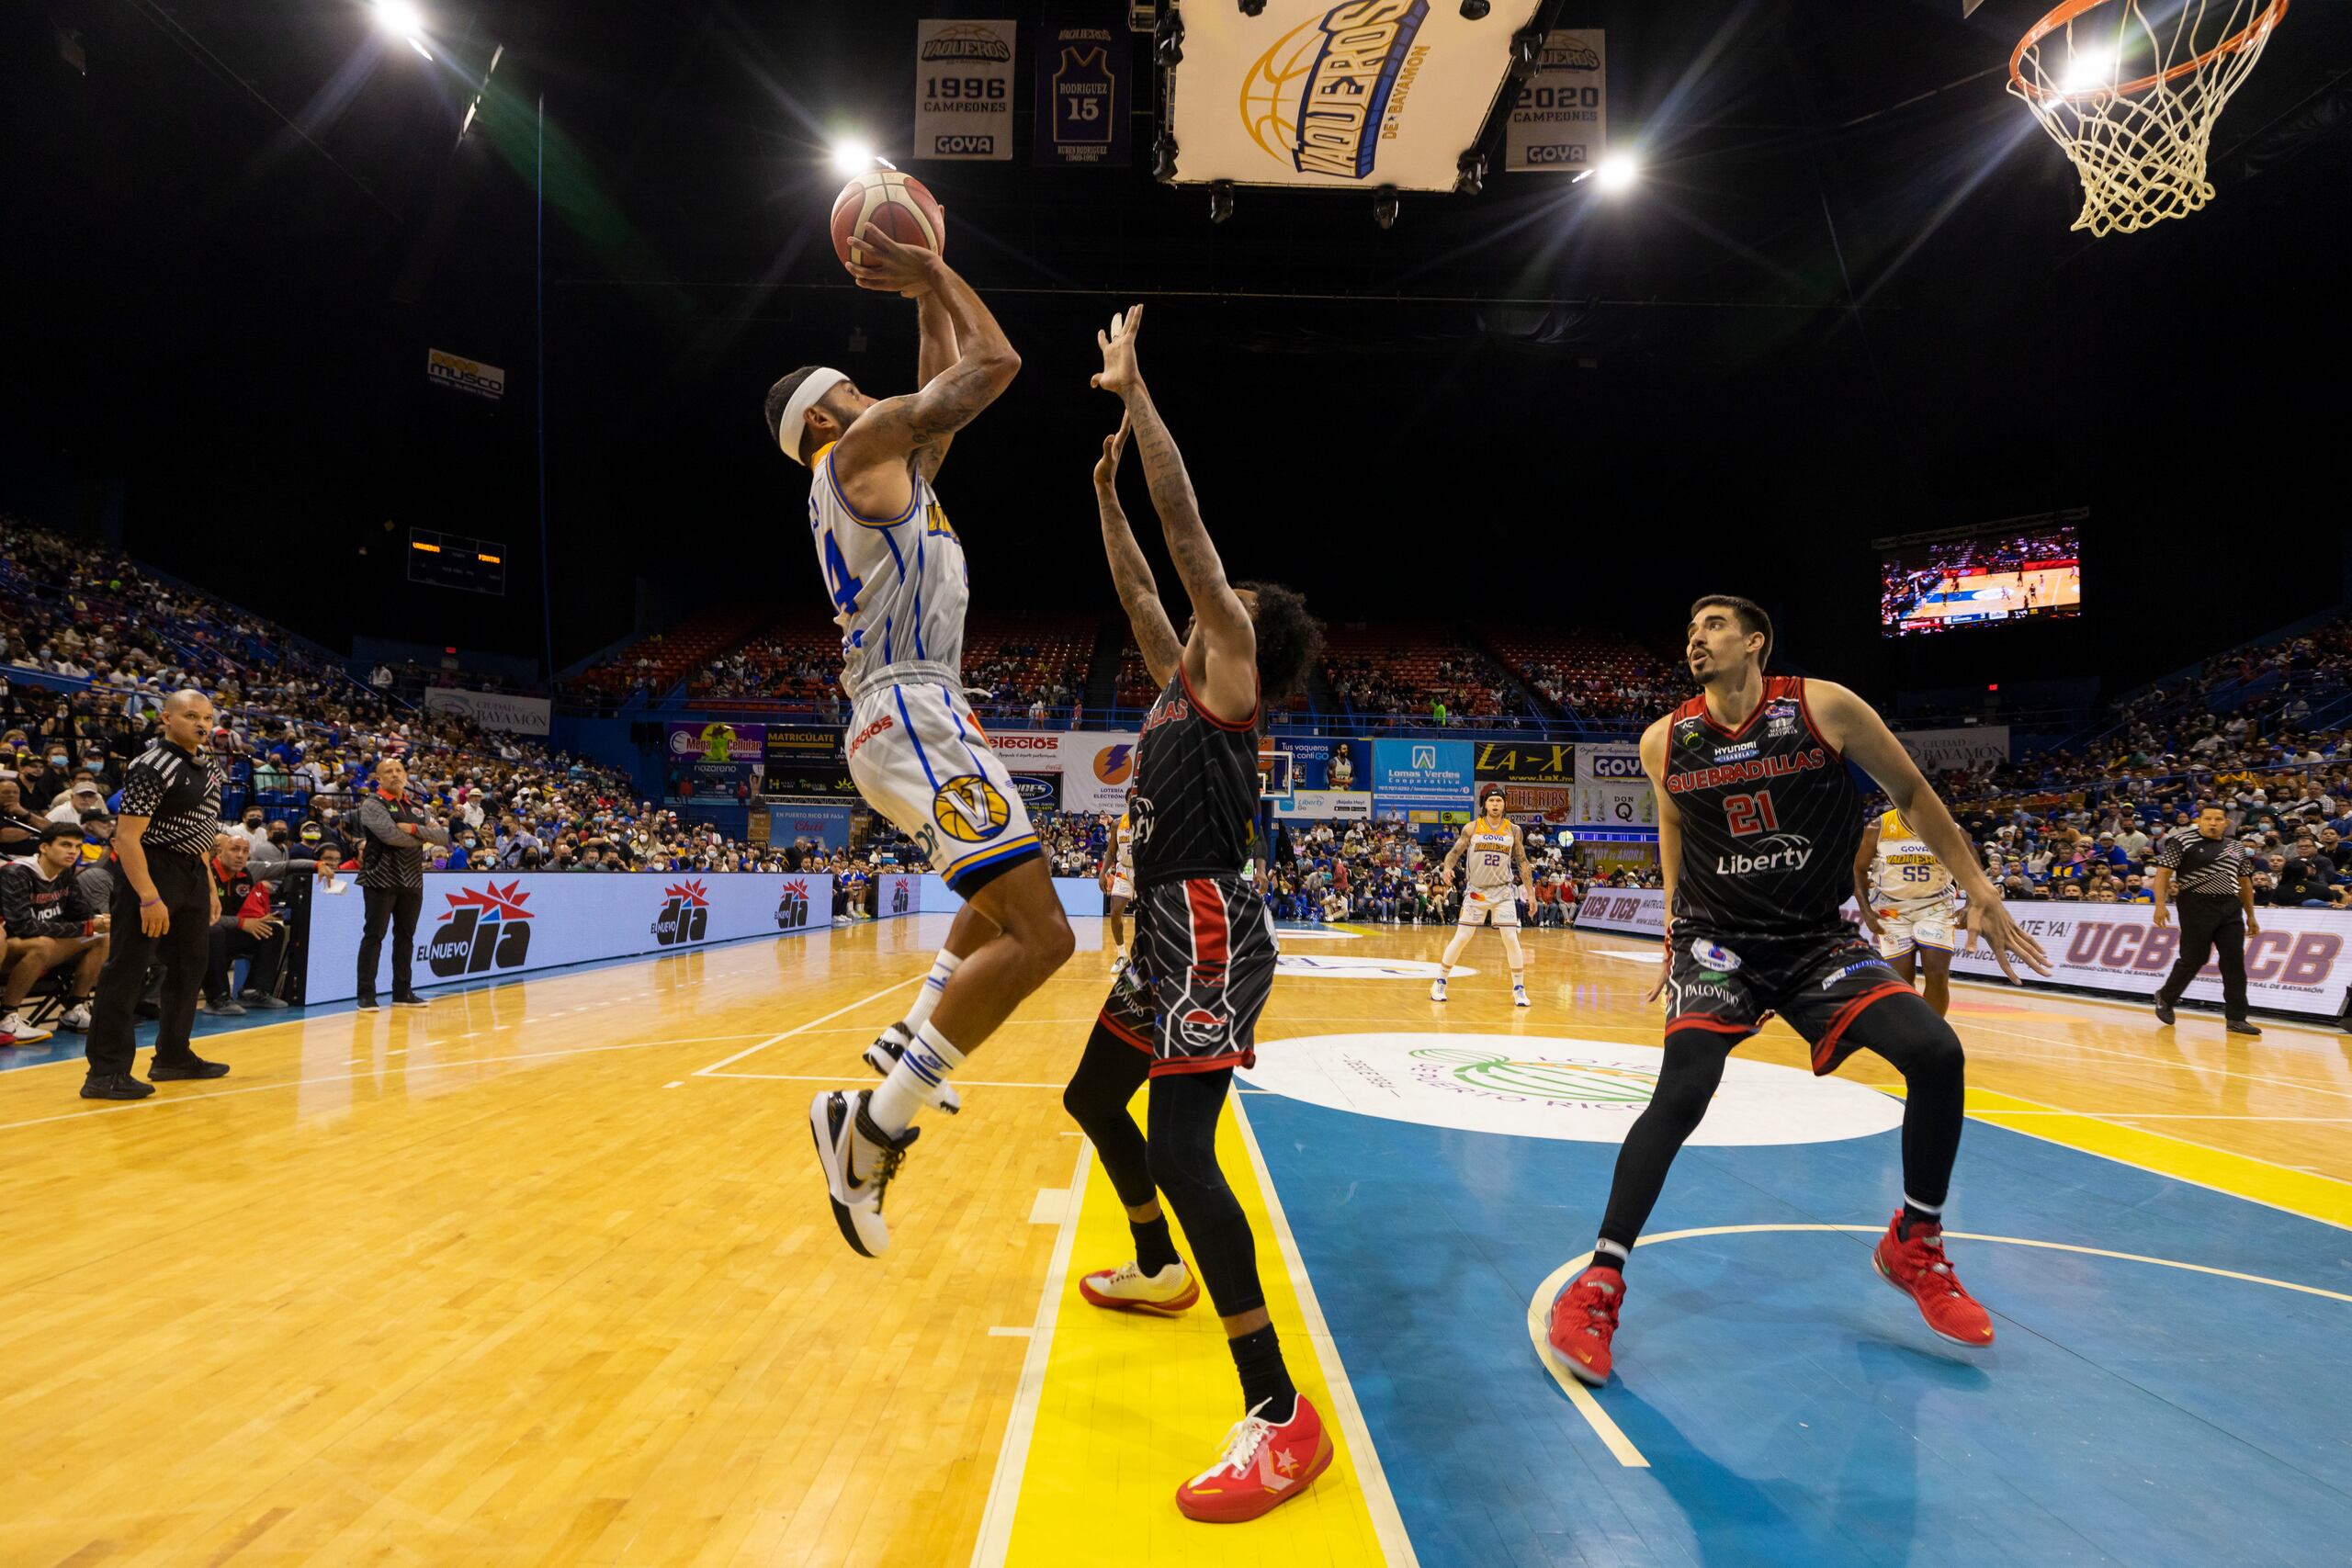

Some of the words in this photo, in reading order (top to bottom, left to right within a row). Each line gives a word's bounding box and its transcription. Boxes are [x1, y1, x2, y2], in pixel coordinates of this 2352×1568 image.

[1058, 28, 1112, 41] VAQUEROS
[922, 39, 1010, 62] VAQUEROS
[1541, 49, 1600, 71] UEROS
[927, 77, 1005, 98] 1996
[1387, 46, 1431, 114] BAYAMON
[1059, 84, 1108, 95] RODRIGUEZ
[1291, 0, 1430, 180] VAQUEROS
[1515, 87, 1599, 108] 2020
[924, 102, 1007, 113] CAMPEONES
[1068, 97, 1100, 120] 15
[1514, 110, 1598, 123] CAMPEONES
[1381, 123, 1399, 140] DE
[936, 137, 992, 154] GOYA
[1078, 146, 1108, 154] RODRIGUEZ
[1528, 145, 1585, 163] GOYA
[430, 363, 503, 392] musco
[476, 701, 515, 712] CIUDAD
[686, 739, 712, 751] Mega
[727, 738, 762, 751] Cellular
[767, 732, 835, 742] MATRICÚLATE
[989, 736, 1058, 750] electos
[1923, 738, 1966, 749] CIUDAD
[1281, 742, 1294, 751] Tus
[1295, 744, 1329, 753] vaqueros
[1714, 740, 1758, 756] HYUNDAI
[1924, 743, 2005, 761] BAYAMÓN
[694, 764, 737, 773] nazareno
[1388, 769, 1420, 778] Lomas
[1424, 770, 1460, 779] Verdes
[1667, 748, 1826, 794] QUEBRADILLAS
[1388, 777, 1461, 785] Cooperativa
[1508, 774, 1574, 783] www.LaX.fm
[1297, 798, 1325, 807] Liberty
[1508, 789, 1532, 806] THE
[1537, 791, 1566, 807] RIBS
[1615, 802, 1634, 823] Q
[1723, 789, 1780, 838] 21
[1484, 853, 1500, 866] 22
[1716, 846, 1814, 875] Liberty
[1903, 865, 1930, 883] 55
[778, 910, 789, 919] NUEVO
[1581, 896, 1611, 917] UCB
[1609, 897, 1642, 920] UCB
[650, 922, 658, 934] EL
[657, 920, 676, 934] NUEVO
[2046, 921, 2073, 937] YA!
[416, 945, 429, 962] EL
[430, 941, 469, 961] NUEVO
[2065, 920, 2180, 972] UCB
[2059, 963, 2096, 972] UNIVERSIDAD
[2097, 966, 2122, 975] CENTRAL
[2132, 970, 2165, 978] BAYAMÓN
[2281, 984, 2325, 994] BAYAMÓN
